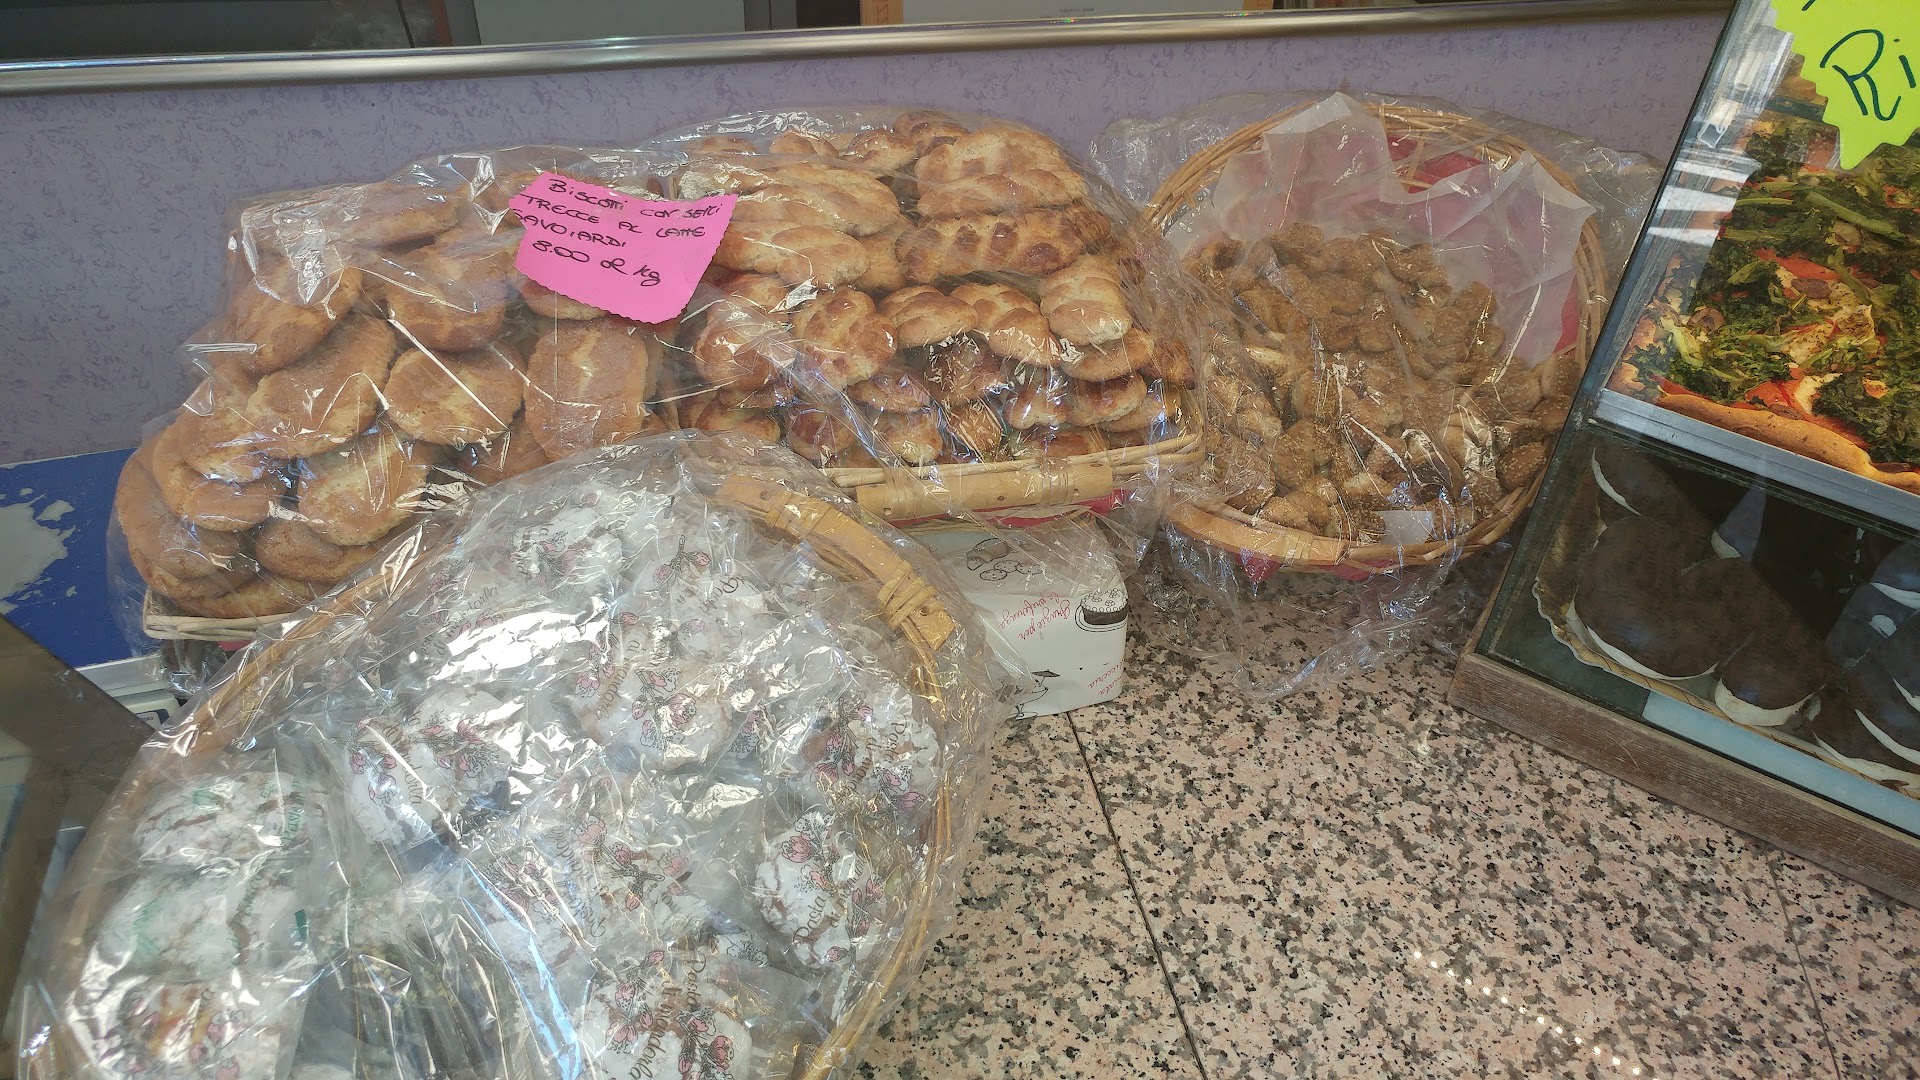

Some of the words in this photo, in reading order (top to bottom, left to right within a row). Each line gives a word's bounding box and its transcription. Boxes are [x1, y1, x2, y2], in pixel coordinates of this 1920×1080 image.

[520, 193, 601, 224] TRECCE
[655, 226, 707, 239] LATTE
[999, 591, 1047, 631] preferenza
[1018, 617, 1036, 641] per
[1036, 599, 1071, 632] Grazie
[793, 896, 827, 943] Pasta
[683, 951, 707, 1007] Pasta
[628, 1003, 672, 1080] mandorla
